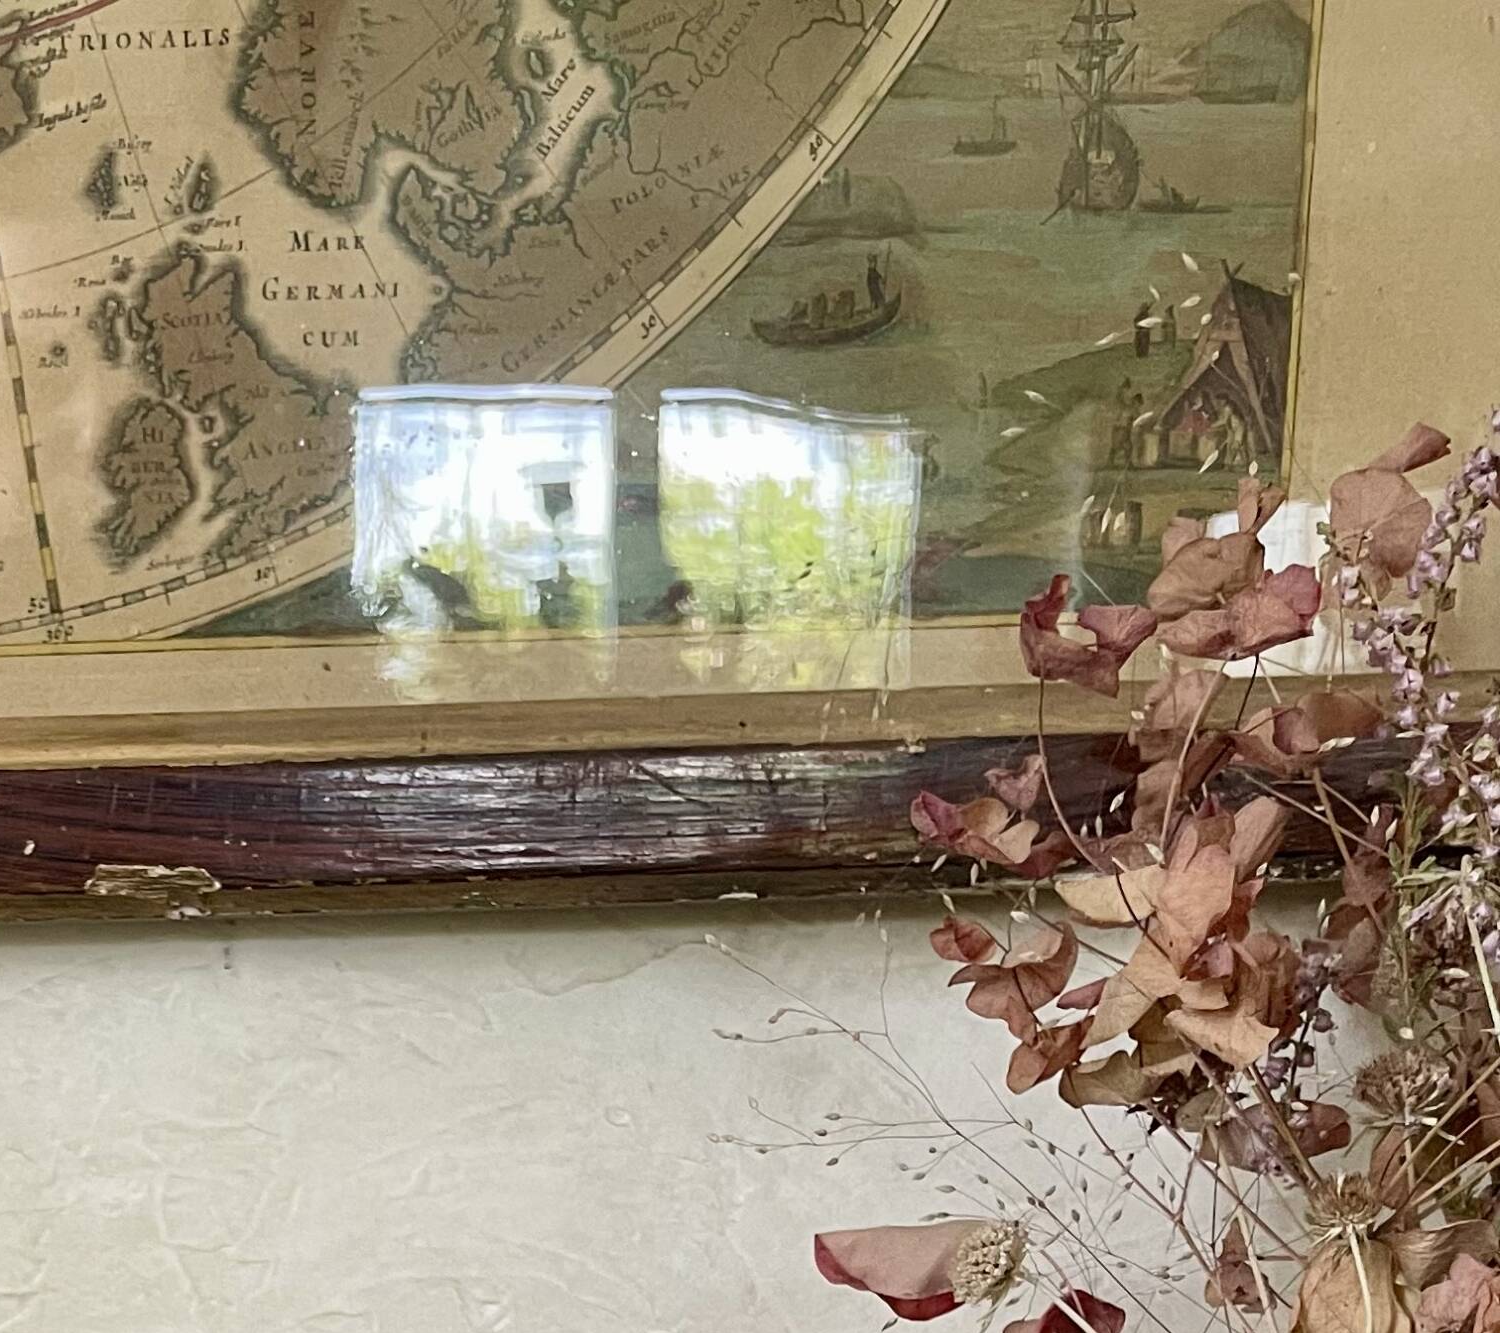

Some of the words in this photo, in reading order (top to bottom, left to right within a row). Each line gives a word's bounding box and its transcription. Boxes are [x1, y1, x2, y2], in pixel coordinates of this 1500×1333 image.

[287, 229, 366, 252] MARE
[261, 276, 399, 301] GERMANI
[301, 330, 360, 348] CUM
